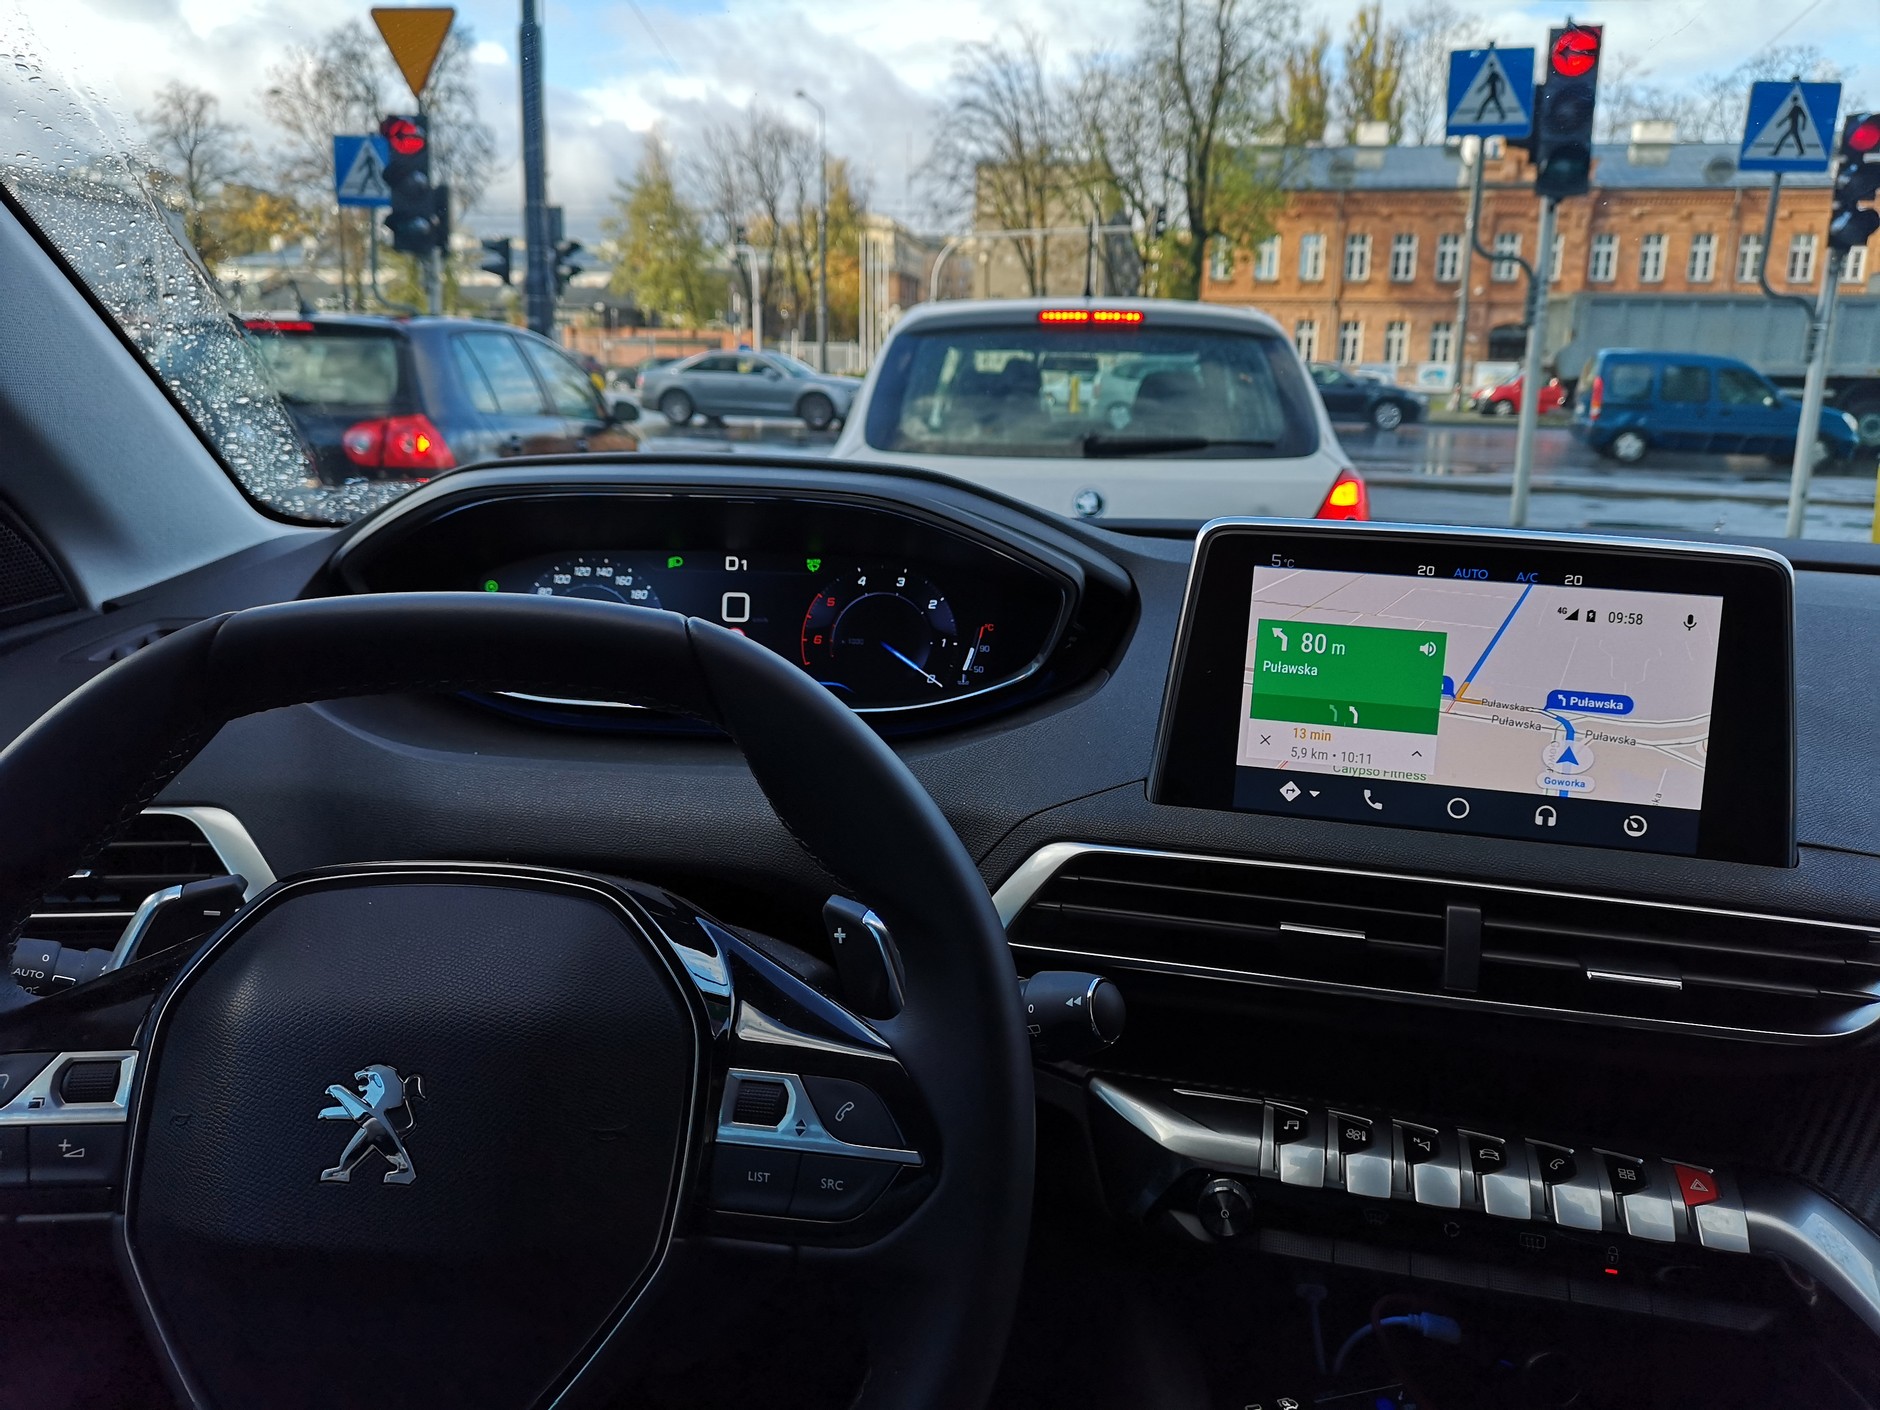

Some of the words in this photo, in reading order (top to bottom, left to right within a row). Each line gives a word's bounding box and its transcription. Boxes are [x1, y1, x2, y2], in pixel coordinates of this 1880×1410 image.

[574, 566, 591, 577] 120
[596, 566, 613, 577] 140
[1417, 565, 1435, 576] 20
[1453, 568, 1489, 580] AUTO
[553, 574, 571, 584] 100
[615, 576, 633, 586] 160
[857, 576, 867, 587] 4
[896, 577, 906, 587] 3
[1516, 572, 1539, 583] A/C
[1564, 574, 1583, 586] 20
[630, 589, 648, 600] 180
[826, 597, 835, 607] 5
[928, 600, 938, 609] 2
[1557, 606, 1568, 615] 4G
[1607, 611, 1644, 626] 09:58
[813, 635, 822, 645] 6
[941, 639, 947, 648] 1
[1301, 632, 1327, 654] 80
[1332, 642, 1346, 655] m
[1263, 660, 1318, 676] Puławska
[1481, 698, 1526, 712] Puławska
[1570, 696, 1624, 711] Puławska
[1491, 714, 1542, 731] Puławska
[1293, 727, 1307, 740] 13
[1310, 730, 1332, 742] min
[1585, 730, 1637, 746] Puławska
[1291, 746, 1308, 759] 5,9
[1311, 748, 1328, 760] km
[1341, 751, 1372, 765] 10:11
[1544, 776, 1586, 788] Goworka
[13, 967, 45, 979] AUTO
[748, 1171, 770, 1183] LIST
[821, 1178, 844, 1191] SRC
